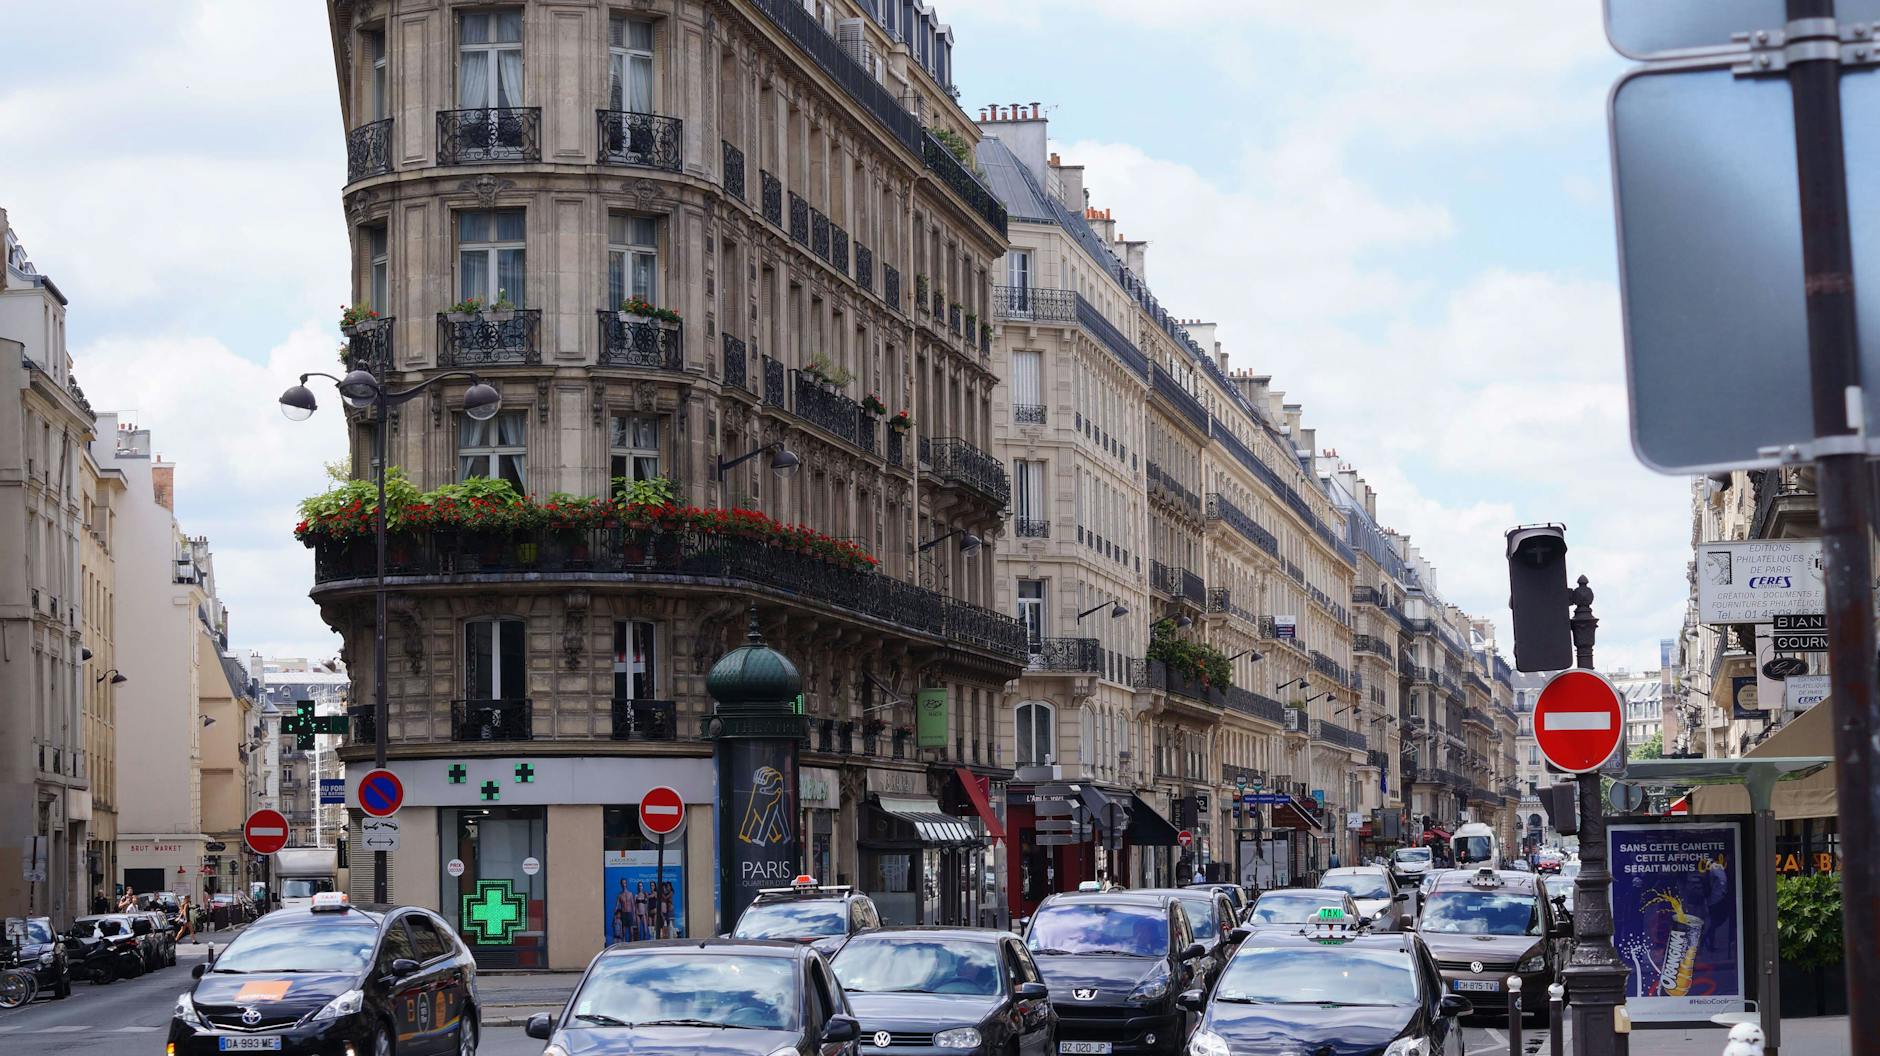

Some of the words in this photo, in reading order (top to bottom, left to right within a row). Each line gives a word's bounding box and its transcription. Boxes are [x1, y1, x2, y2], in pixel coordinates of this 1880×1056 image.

[1750, 566, 1761, 574] DE
[1765, 565, 1791, 574] PARIS
[1763, 590, 1812, 599] DOCUMENTS
[1712, 601, 1767, 609] FOURNITURES
[1744, 610, 1756, 619] 01
[1761, 609, 1774, 619] 45
[1777, 617, 1822, 627] BIAN
[1777, 637, 1829, 648] GOURM
[130, 844, 149, 852] BRUT
[1620, 843, 1647, 852] SANS
[1649, 843, 1679, 852] CETTE
[1681, 842, 1725, 851] CANETTE
[1635, 854, 1665, 863] CETTE
[1667, 853, 1710, 862] AFFICHE
[742, 860, 791, 879] PARIS
[1624, 864, 1660, 873] SERAIT
[1662, 863, 1696, 872] MOINS
[1321, 908, 1343, 918] TAXI
[1661, 930, 1686, 990] ORANGINA
